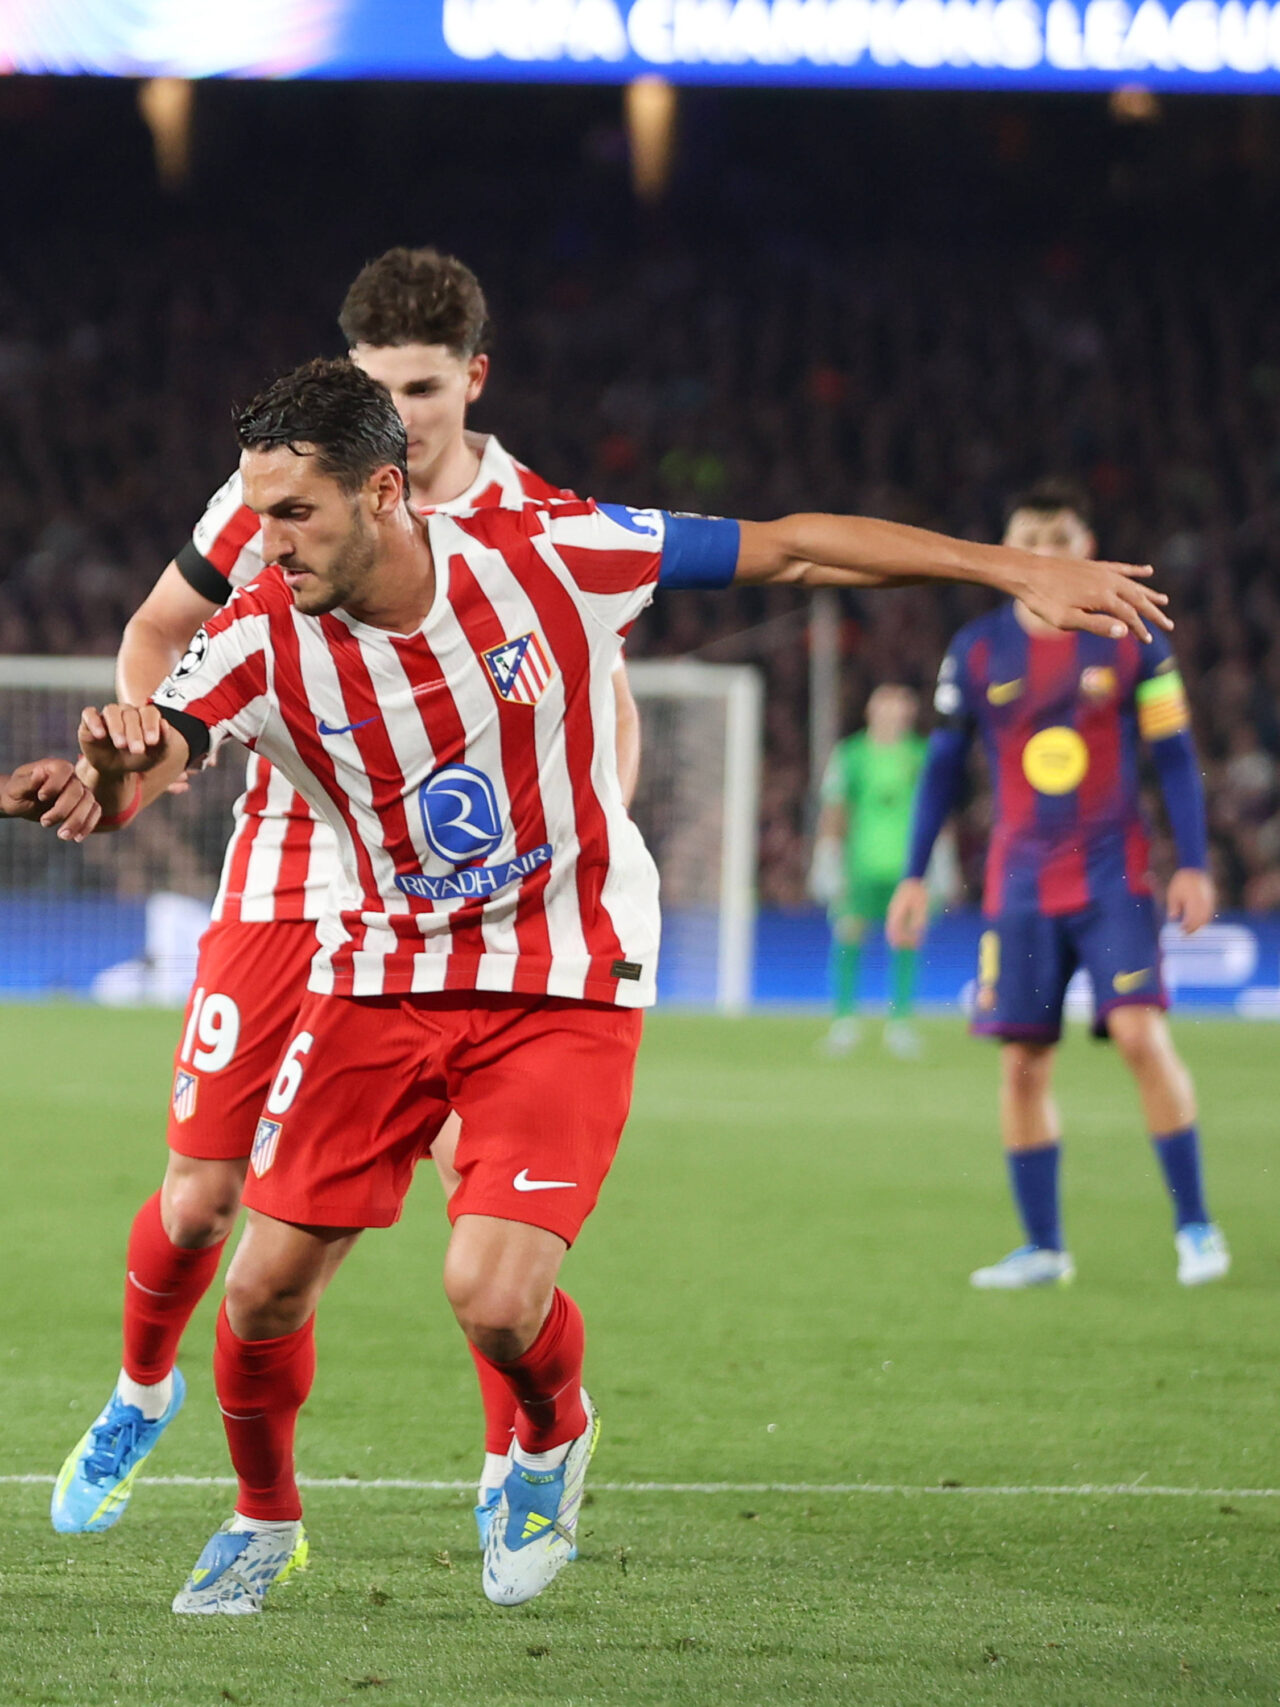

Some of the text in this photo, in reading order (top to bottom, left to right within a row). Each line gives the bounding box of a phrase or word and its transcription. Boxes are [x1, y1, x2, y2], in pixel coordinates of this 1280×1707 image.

[442, 0, 1280, 72] UEFA CHAMPIONS LEAGU
[400, 847, 549, 898] RIYADH AIR
[180, 987, 240, 1073] 19
[266, 1031, 314, 1115] 6
